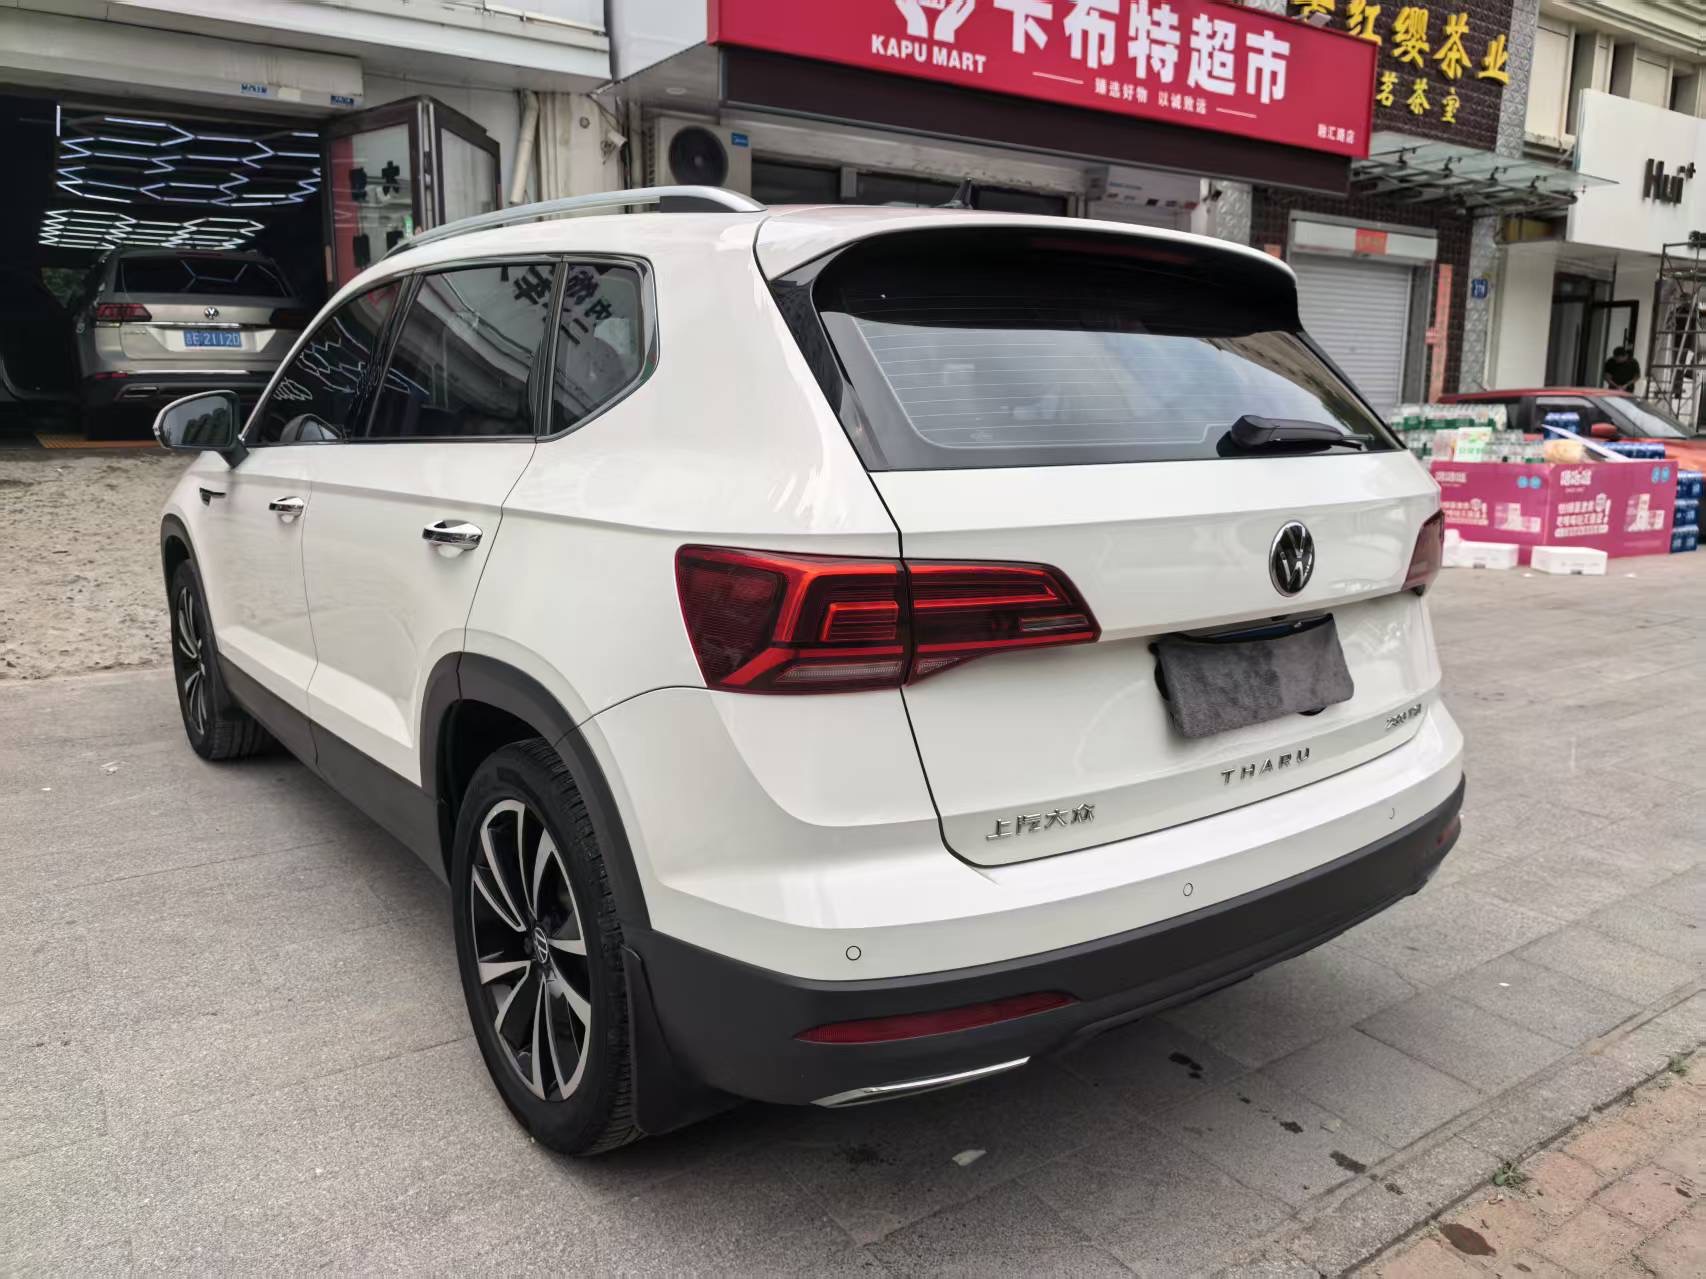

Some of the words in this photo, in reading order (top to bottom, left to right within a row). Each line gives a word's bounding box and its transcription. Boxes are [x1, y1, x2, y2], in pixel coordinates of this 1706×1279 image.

[871, 34, 928, 63] KAPU
[932, 46, 987, 74] MART
[1221, 747, 1310, 785] THARU
[985, 803, 1096, 841] 上汽大众
